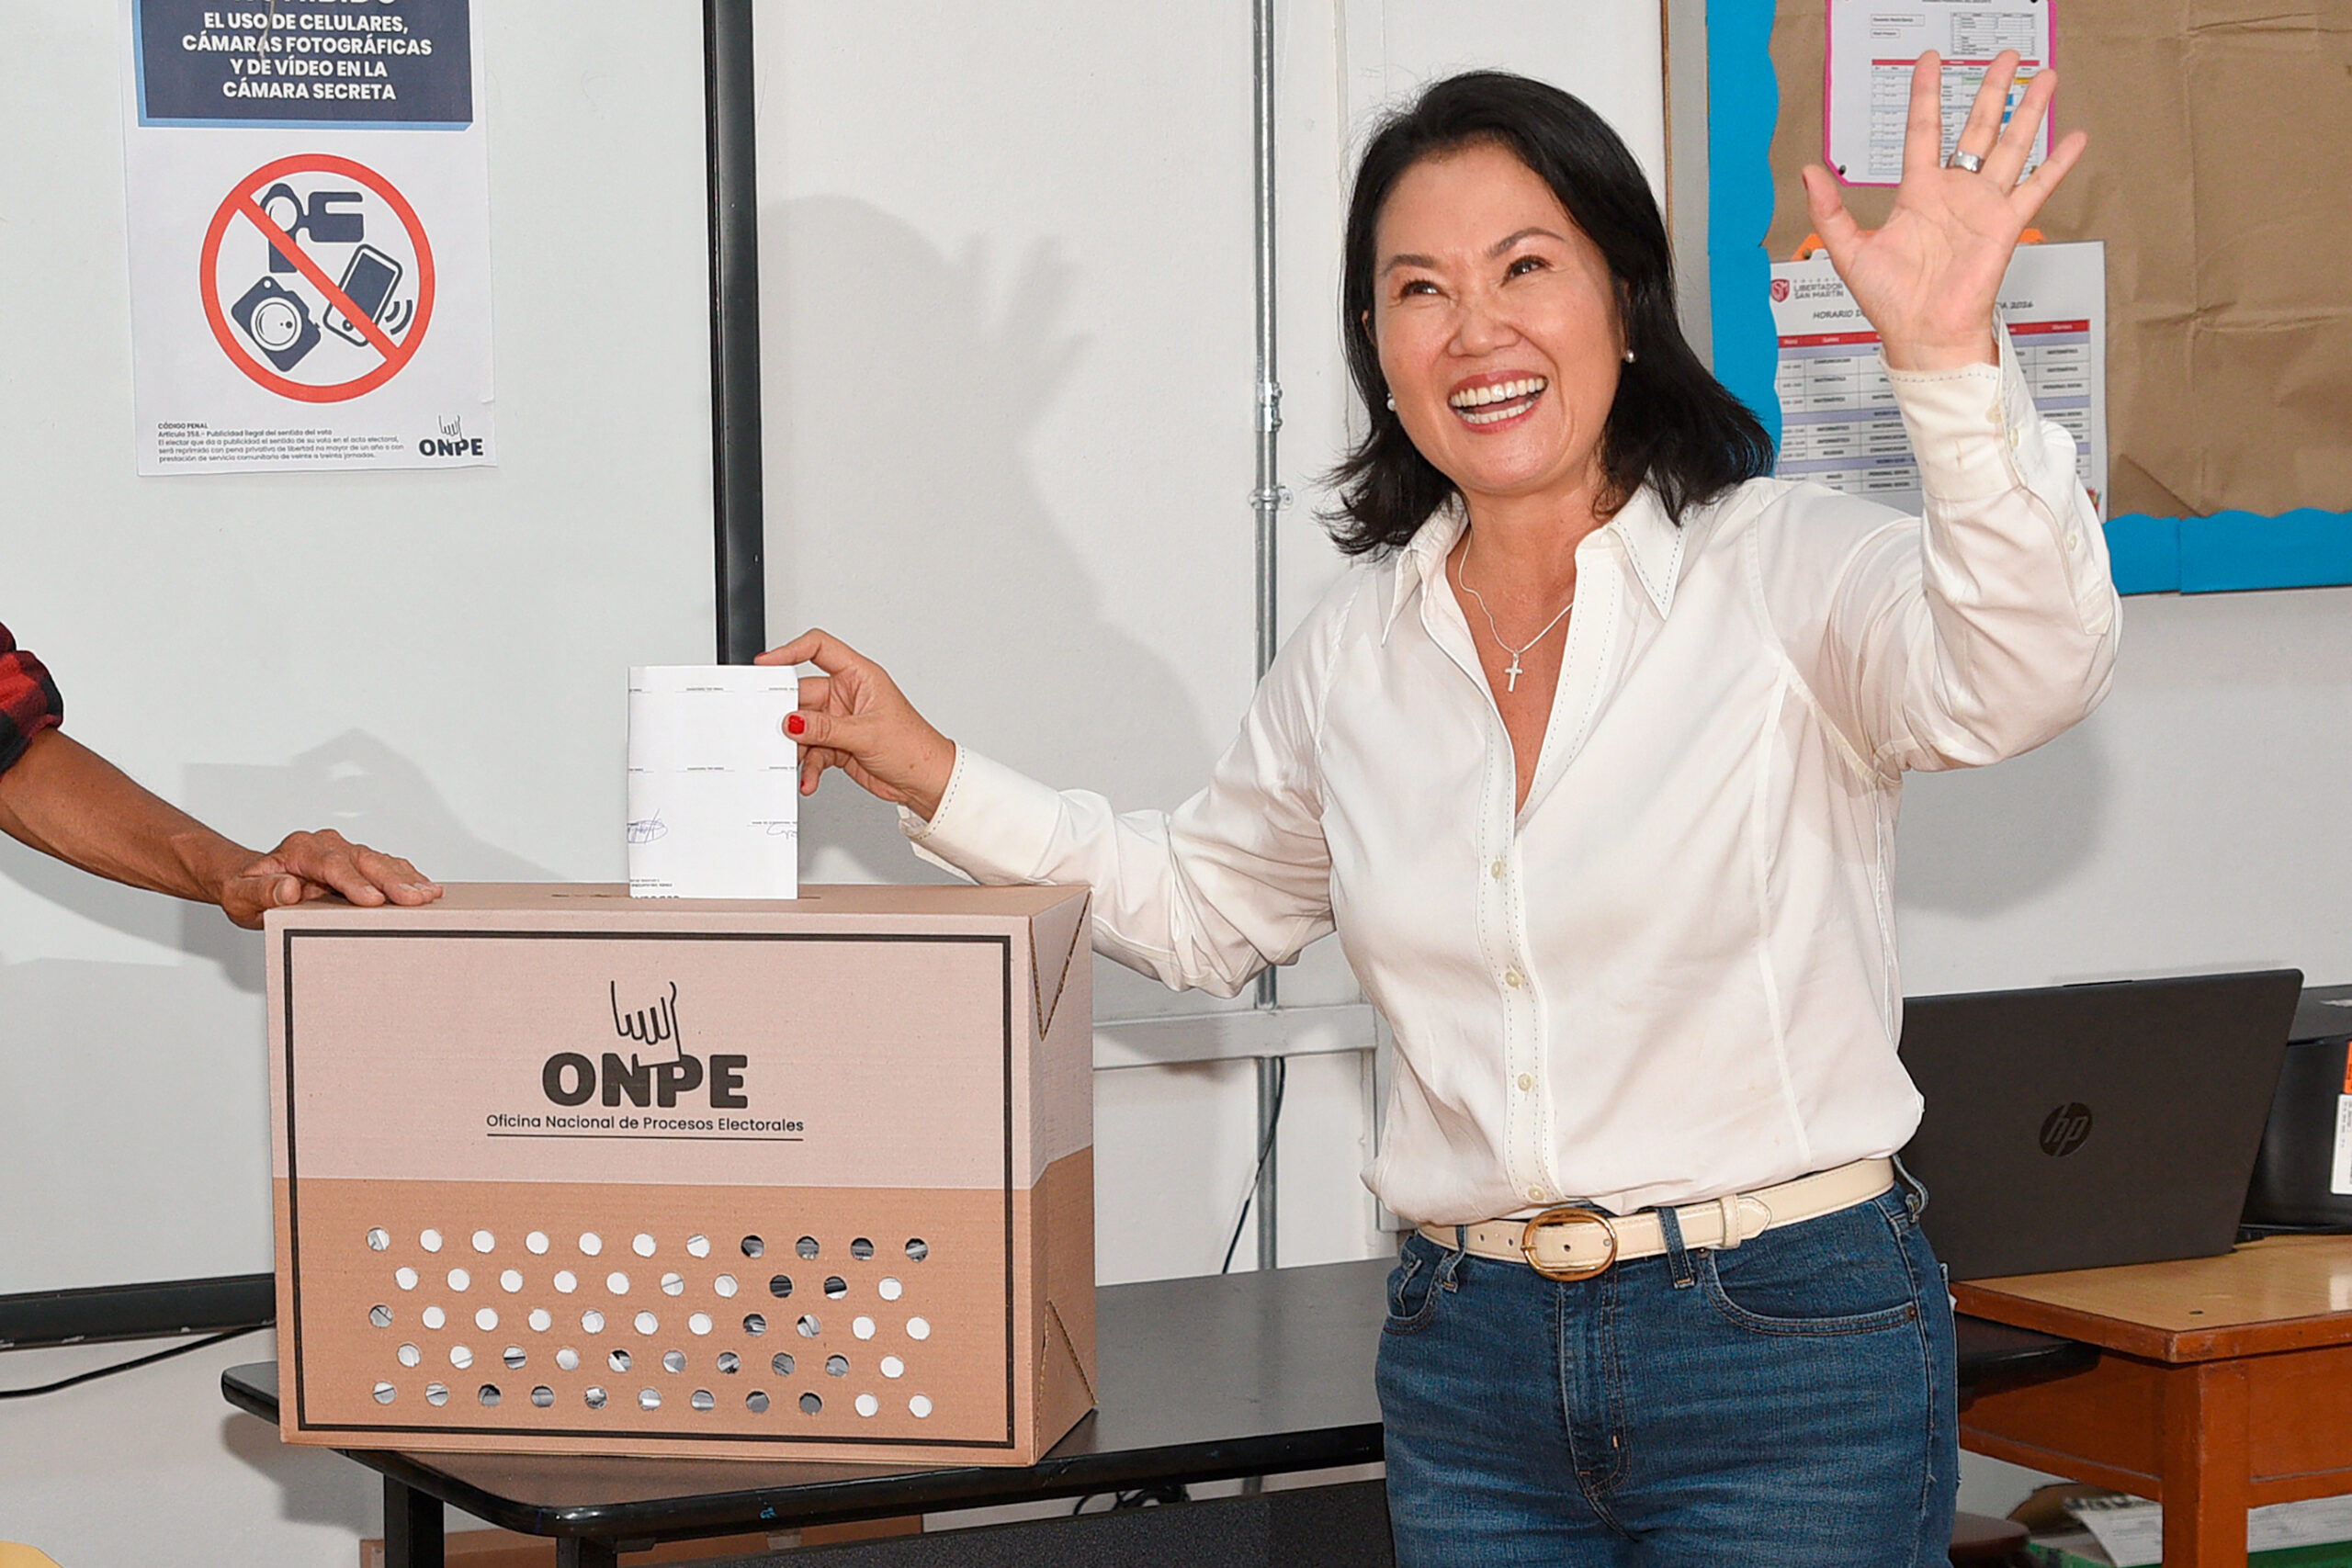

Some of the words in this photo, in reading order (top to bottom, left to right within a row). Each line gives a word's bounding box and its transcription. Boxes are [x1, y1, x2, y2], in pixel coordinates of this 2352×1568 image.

[204, 12, 224, 28] EL
[227, 13, 268, 30] USO
[272, 14, 297, 30] DE
[300, 14, 409, 35] CELULARES,
[182, 30, 282, 53] CÁMARAS
[286, 31, 433, 55] FOTOGRÁFICAS
[230, 59, 243, 75] Y
[247, 59, 271, 75] DE
[275, 55, 334, 76] VÍDEO
[337, 60, 360, 77] EN
[364, 61, 388, 77] LA
[222, 78, 310, 99] CÁMARA
[312, 82, 397, 101] SECRETA
[158, 422, 186, 430] CÓDIGO
[206, 429, 243, 437] Publicidad
[266, 428, 277, 436] del
[304, 428, 316, 436] del
[165, 438, 189, 446] elector
[190, 439, 204, 447] que
[223, 437, 260, 446] publicidad
[225, 446, 243, 455] pena
[418, 437, 484, 457] ONPE
[198, 454, 207, 462] de
[541, 1051, 749, 1109] ONPE
[486, 1114, 541, 1129] Oficina
[546, 1115, 616, 1130] Nacional
[618, 1115, 639, 1130] de
[643, 1116, 714, 1131] Procesos
[718, 1117, 805, 1132] Electorales
[2040, 1101, 2094, 1157] hp
